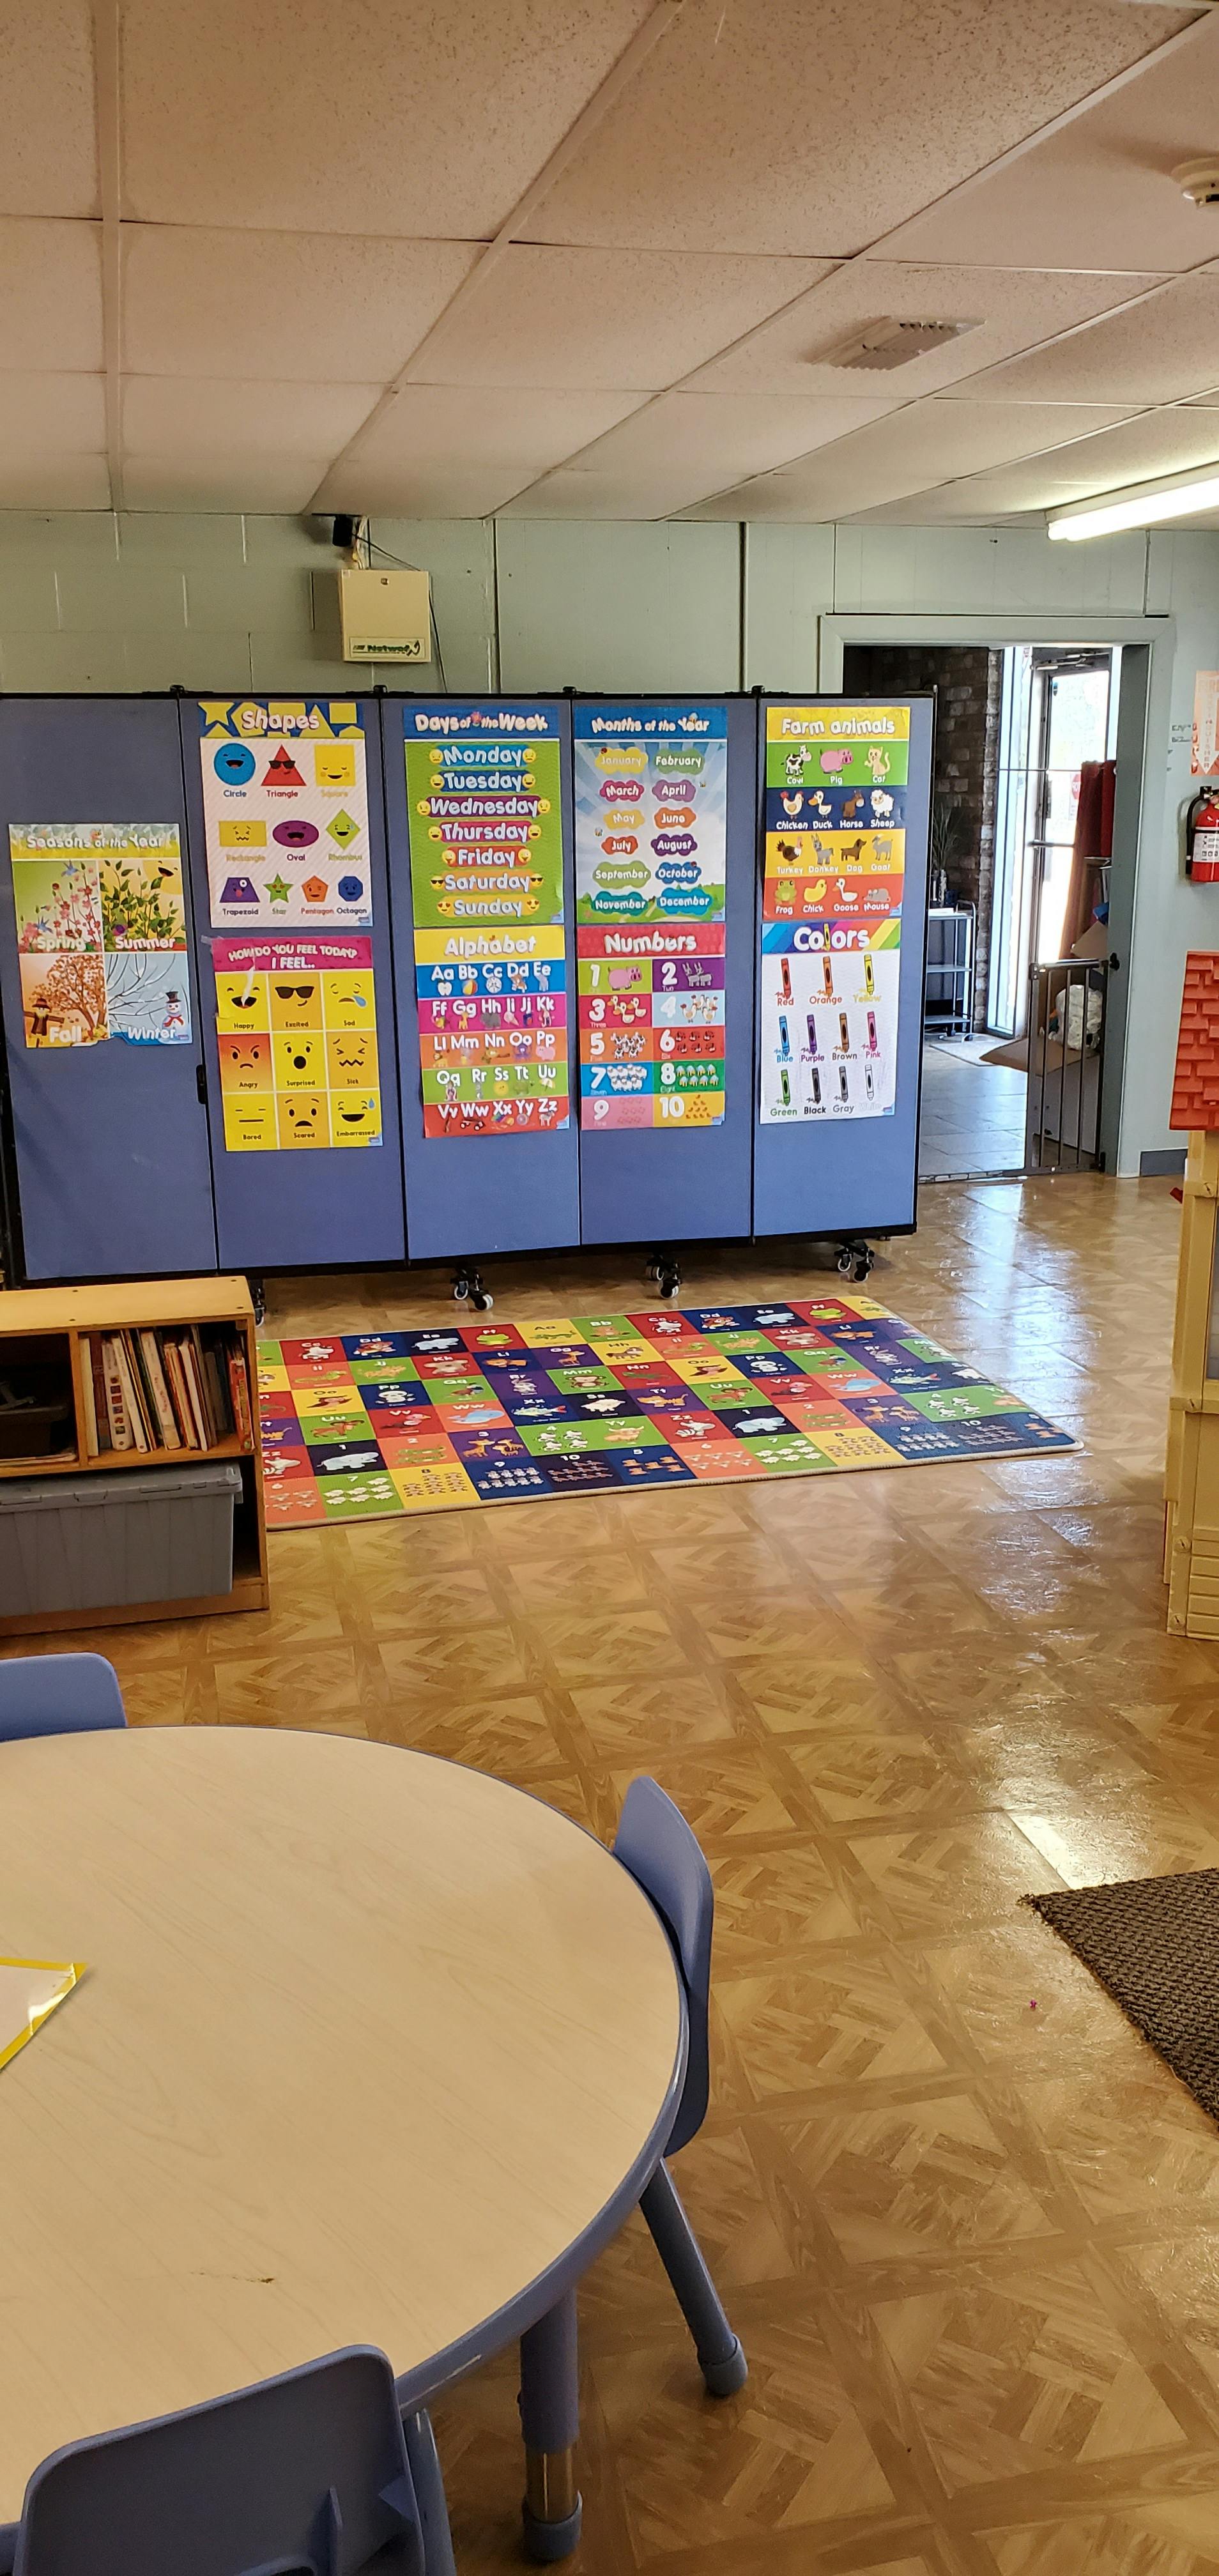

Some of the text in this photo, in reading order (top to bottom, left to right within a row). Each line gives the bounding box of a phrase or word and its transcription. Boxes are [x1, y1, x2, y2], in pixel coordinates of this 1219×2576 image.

[241, 709, 320, 733] Shapes
[415, 713, 548, 734] Days of the Week
[592, 716, 710, 733] Months of the Year
[781, 717, 895, 735] Farm animals
[442, 746, 522, 767] Monday
[601, 755, 641, 767] January
[656, 756, 702, 767] February
[444, 772, 522, 792] Tuesday
[787, 776, 804, 785] Cow
[831, 776, 843, 785] Pig
[873, 775, 886, 783] Cat
[606, 786, 639, 796] March
[661, 785, 686, 797] April
[430, 797, 538, 818] Wednesday
[613, 813, 634, 824] May
[661, 813, 686, 823] June
[840, 819, 863, 828] Horse
[870, 818, 894, 829] Sheep
[776, 820, 808, 830] Chicken
[813, 820, 832, 829] Duck
[441, 823, 528, 843] Thursday
[27, 836, 91, 848] Seasons
[95, 838, 107, 848] of
[110, 837, 127, 848] the
[611, 841, 631, 852] July
[657, 839, 692, 851] August
[458, 848, 515, 868] Friday
[595, 869, 648, 880] September
[658, 868, 698, 878] October
[777, 866, 803, 875] Turkey
[808, 864, 838, 873] Donkey
[847, 864, 862, 873] Dog
[445, 873, 530, 893] Saturday
[454, 898, 522, 917] Sunday
[595, 898, 647, 910] November
[659, 896, 710, 907] December
[834, 903, 859, 912] Goose
[864, 902, 889, 911] Mouse
[776, 905, 793, 915] Frog
[802, 904, 824, 913] Chick
[37, 937, 86, 951] Spring
[116, 937, 176, 949] Summer
[604, 931, 696, 954] Numbers
[793, 926, 870, 951] Colors
[445, 935, 536, 958] Alphabet
[229, 944, 357, 962] HOW DO YOU FEEL TODAY?
[272, 957, 277, 969] I
[432, 962, 551, 981] Aa Bb Cc Dd Ee
[590, 964, 600, 986] 1
[661, 962, 677, 986] 2
[778, 997, 794, 1006] Red
[809, 995, 843, 1006] Orange
[853, 994, 882, 1002] Yellow
[432, 996, 555, 1017] Ff Gg Hh Ii Jj Kk
[589, 999, 606, 1022] 3
[661, 996, 677, 1018] 4
[50, 1026, 82, 1042] Fall
[128, 1026, 176, 1039] Winter
[434, 1030, 555, 1051] Ll Mm Nn Oo Pp
[590, 1032, 604, 1055] 5
[660, 1029, 675, 1052] 6
[777, 1054, 793, 1062] Blue
[801, 1054, 825, 1063] Purple
[436, 1064, 556, 1086] Qq Rr Ss Tt Uu
[591, 1067, 606, 1089] 7
[661, 1062, 676, 1084] 8
[438, 1098, 557, 1119] Vv Ww Xx Yy Zz
[594, 1100, 609, 1121] 9
[659, 1096, 685, 1118] 10
[804, 1106, 826, 1115] Black
[832, 1105, 854, 1114] Gray
